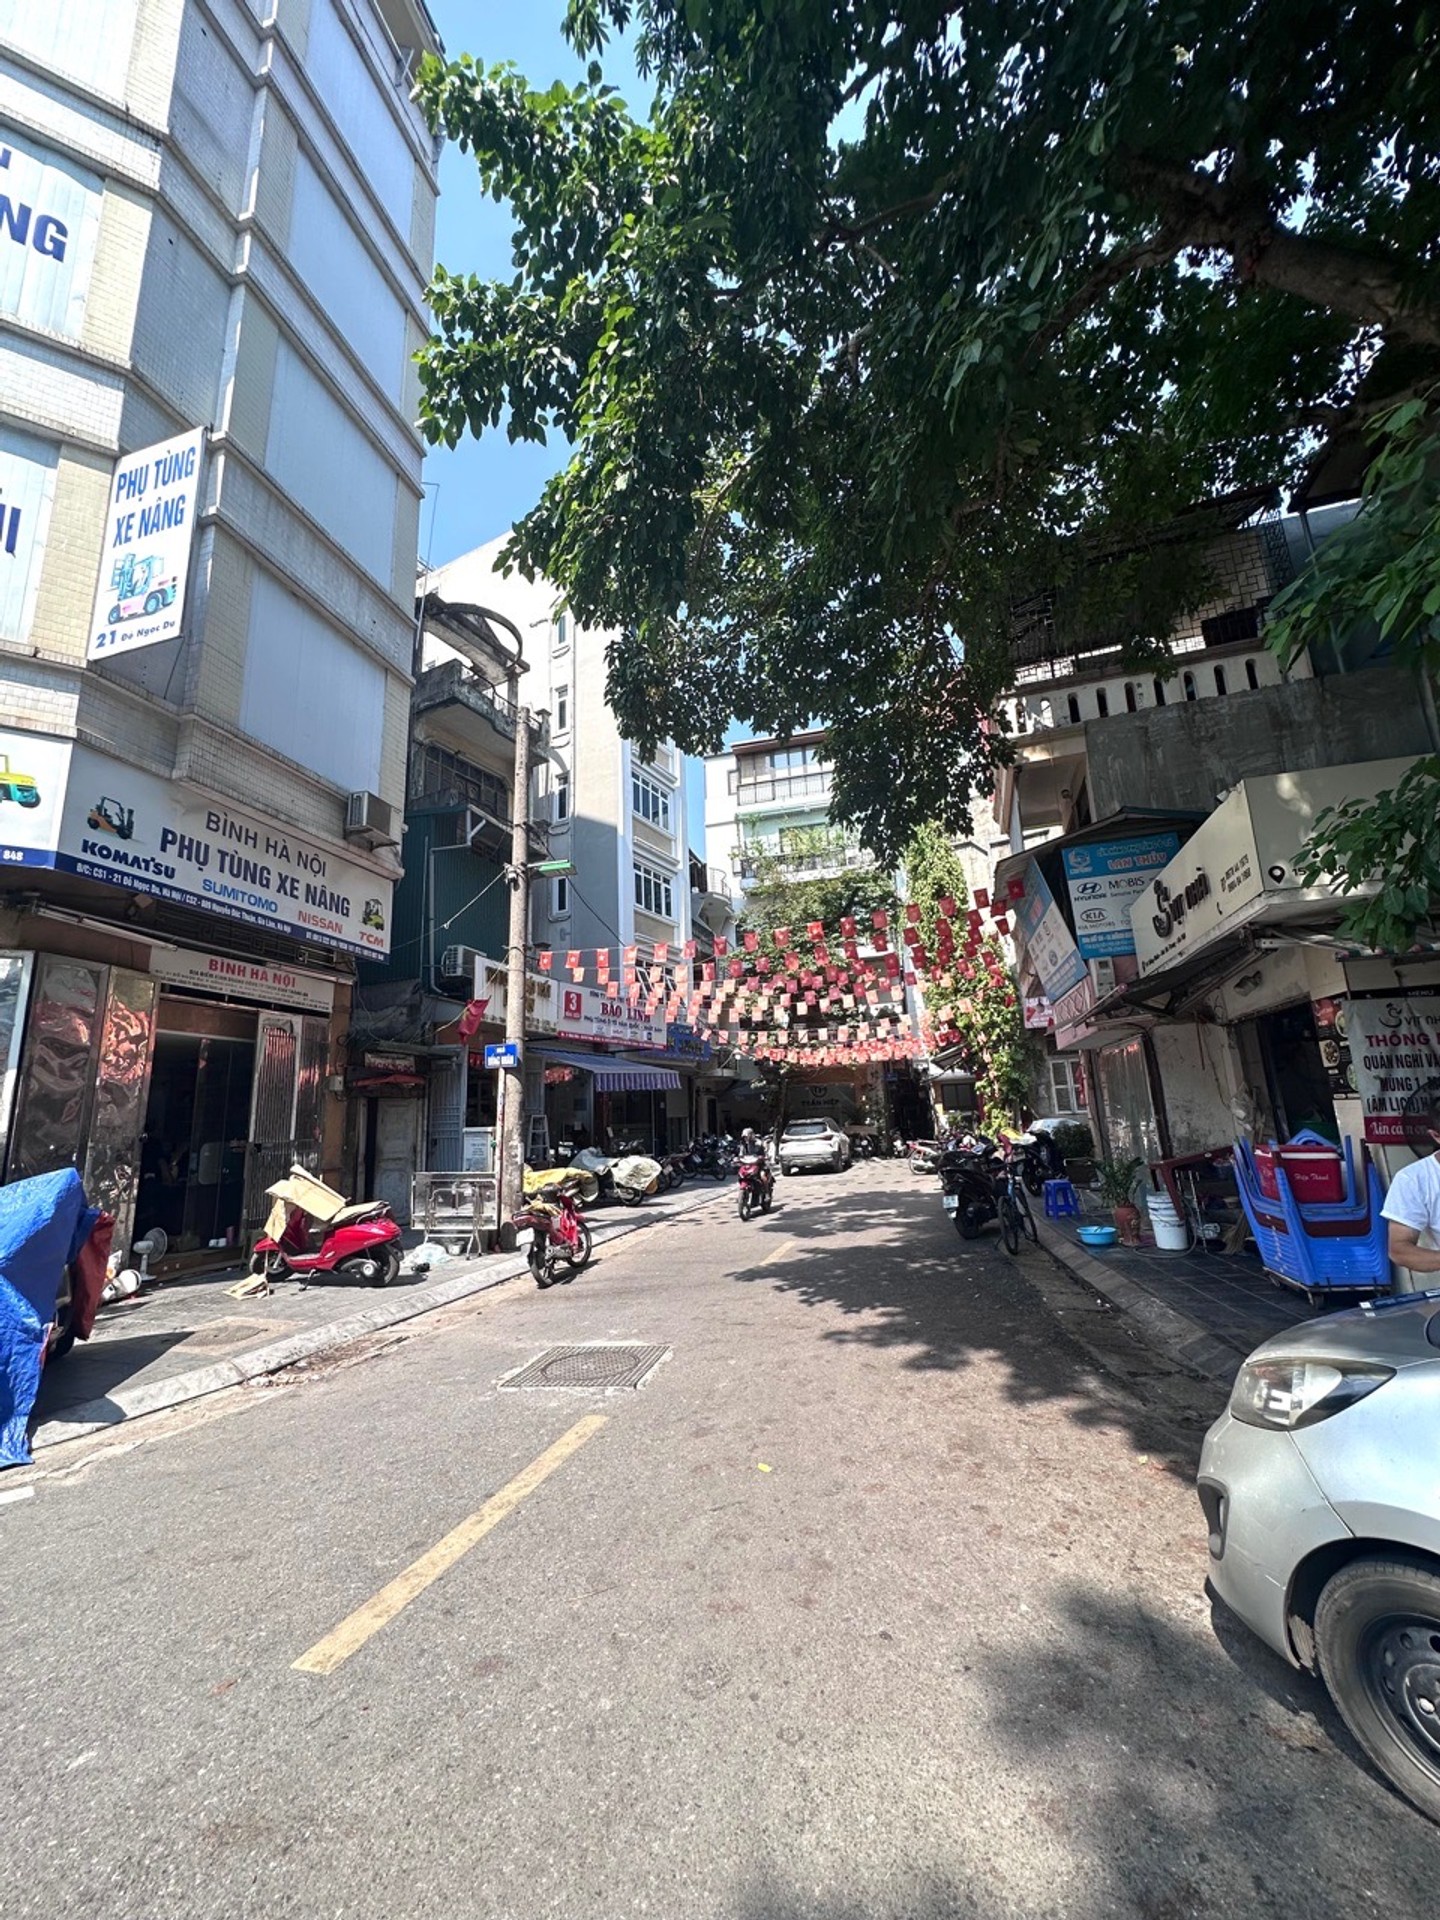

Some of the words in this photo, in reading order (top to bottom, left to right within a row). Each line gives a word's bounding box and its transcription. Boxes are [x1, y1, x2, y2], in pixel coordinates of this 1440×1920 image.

[115, 464, 150, 503] PHỤ
[153, 446, 197, 490] TÙNG
[113, 512, 136, 548] XE
[138, 494, 187, 539] NÂNG
[95, 630, 117, 649] 21
[163, 620, 175, 630] Du
[81, 838, 177, 880] KOMATSU
[205, 811, 258, 849] BÌNH
[265, 836, 291, 863] HÀ
[297, 851, 326, 878] NỘI
[113, 873, 121, 884] 21
[160, 827, 210, 872] PHỤ
[217, 849, 272, 889] TÙNG
[276, 871, 300, 900] XE
[305, 883, 351, 918] NÂNG
[1108, 877, 1145, 889] MOBIS
[202, 878, 278, 913] SUMITOMO
[297, 911, 343, 934] NISSAN
[1085, 910, 1105, 919] KIA
[359, 931, 384, 947] TCM
[208, 958, 246, 978] BÌNH
[250, 966, 269, 983] HÀ
[273, 973, 296, 988] NỘI
[569, 992, 578, 1011] 3
[1365, 1030, 1431, 1047] THÔNG
